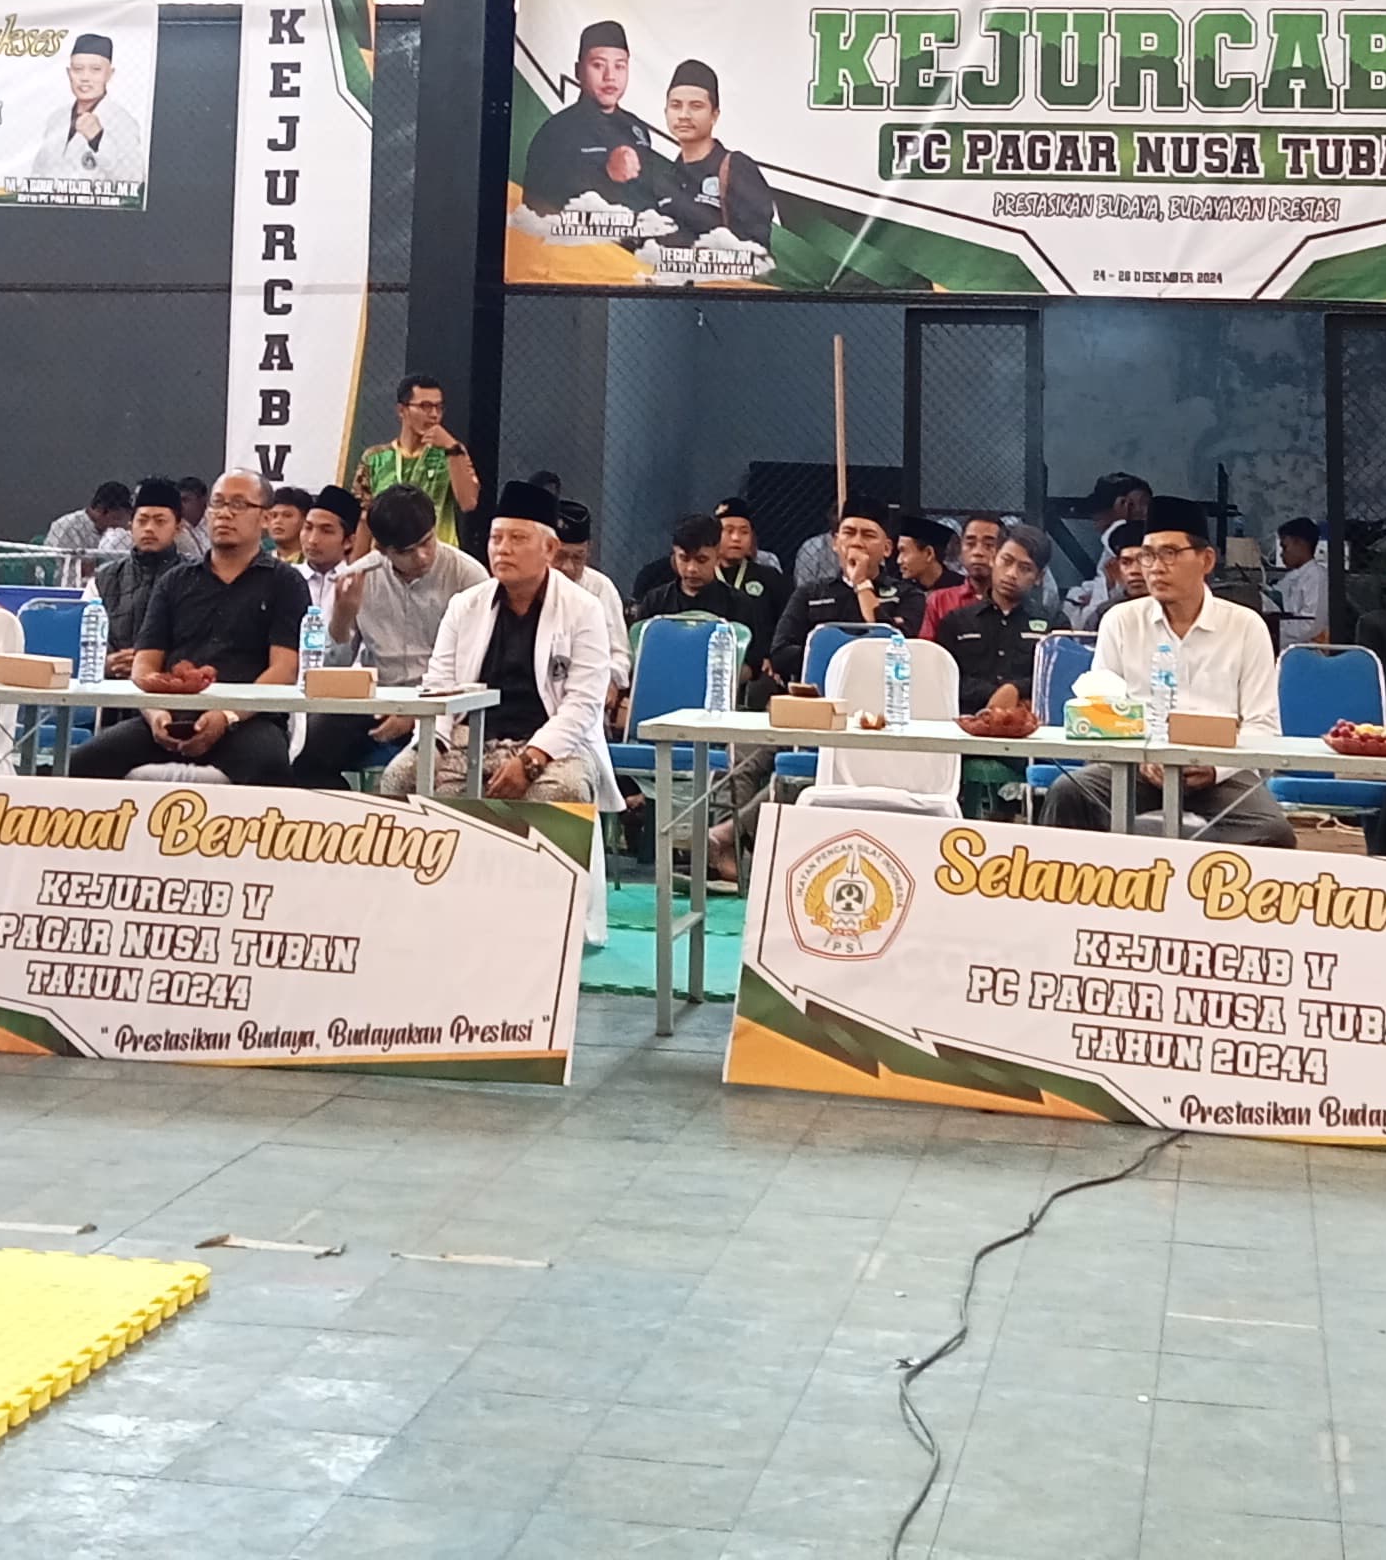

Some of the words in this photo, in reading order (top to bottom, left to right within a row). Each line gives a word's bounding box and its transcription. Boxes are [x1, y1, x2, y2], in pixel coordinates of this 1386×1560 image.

[892, 130, 951, 176] PC
[963, 130, 1120, 176] PAGAR
[1132, 130, 1264, 178] NUSA
[993, 192, 1094, 217] PRESTASIKAN
[1096, 193, 1164, 222] BUDAYA,
[1168, 195, 1262, 221] BUDAYAKAN
[1268, 196, 1341, 221] PRESTASI
[1197, 272, 1223, 284] 2024
[147, 789, 460, 886] Bertanding
[37, 870, 233, 917] KEJURCAB
[242, 882, 273, 920] V
[934, 827, 1175, 913] Selamat
[120, 921, 221, 965] NUSA
[231, 928, 361, 974] TUBAN
[1074, 929, 1293, 986] KEJURCAB
[1305, 951, 1338, 990] V
[26, 960, 144, 1002] TAHUN
[147, 969, 252, 1011] 20244
[967, 964, 1020, 1007] PC
[1029, 971, 1163, 1022] PAGAR
[1174, 986, 1286, 1035] NUSA
[115, 1024, 231, 1053] Prestasikan
[237, 1020, 321, 1056] Budaya,
[327, 1017, 442, 1053] Budayakan
[449, 1014, 533, 1043] Prestasi
[1072, 1023, 1203, 1072] TAHUN
[1211, 1039, 1328, 1085] 20244
[1179, 1094, 1312, 1127] Prestasikan
